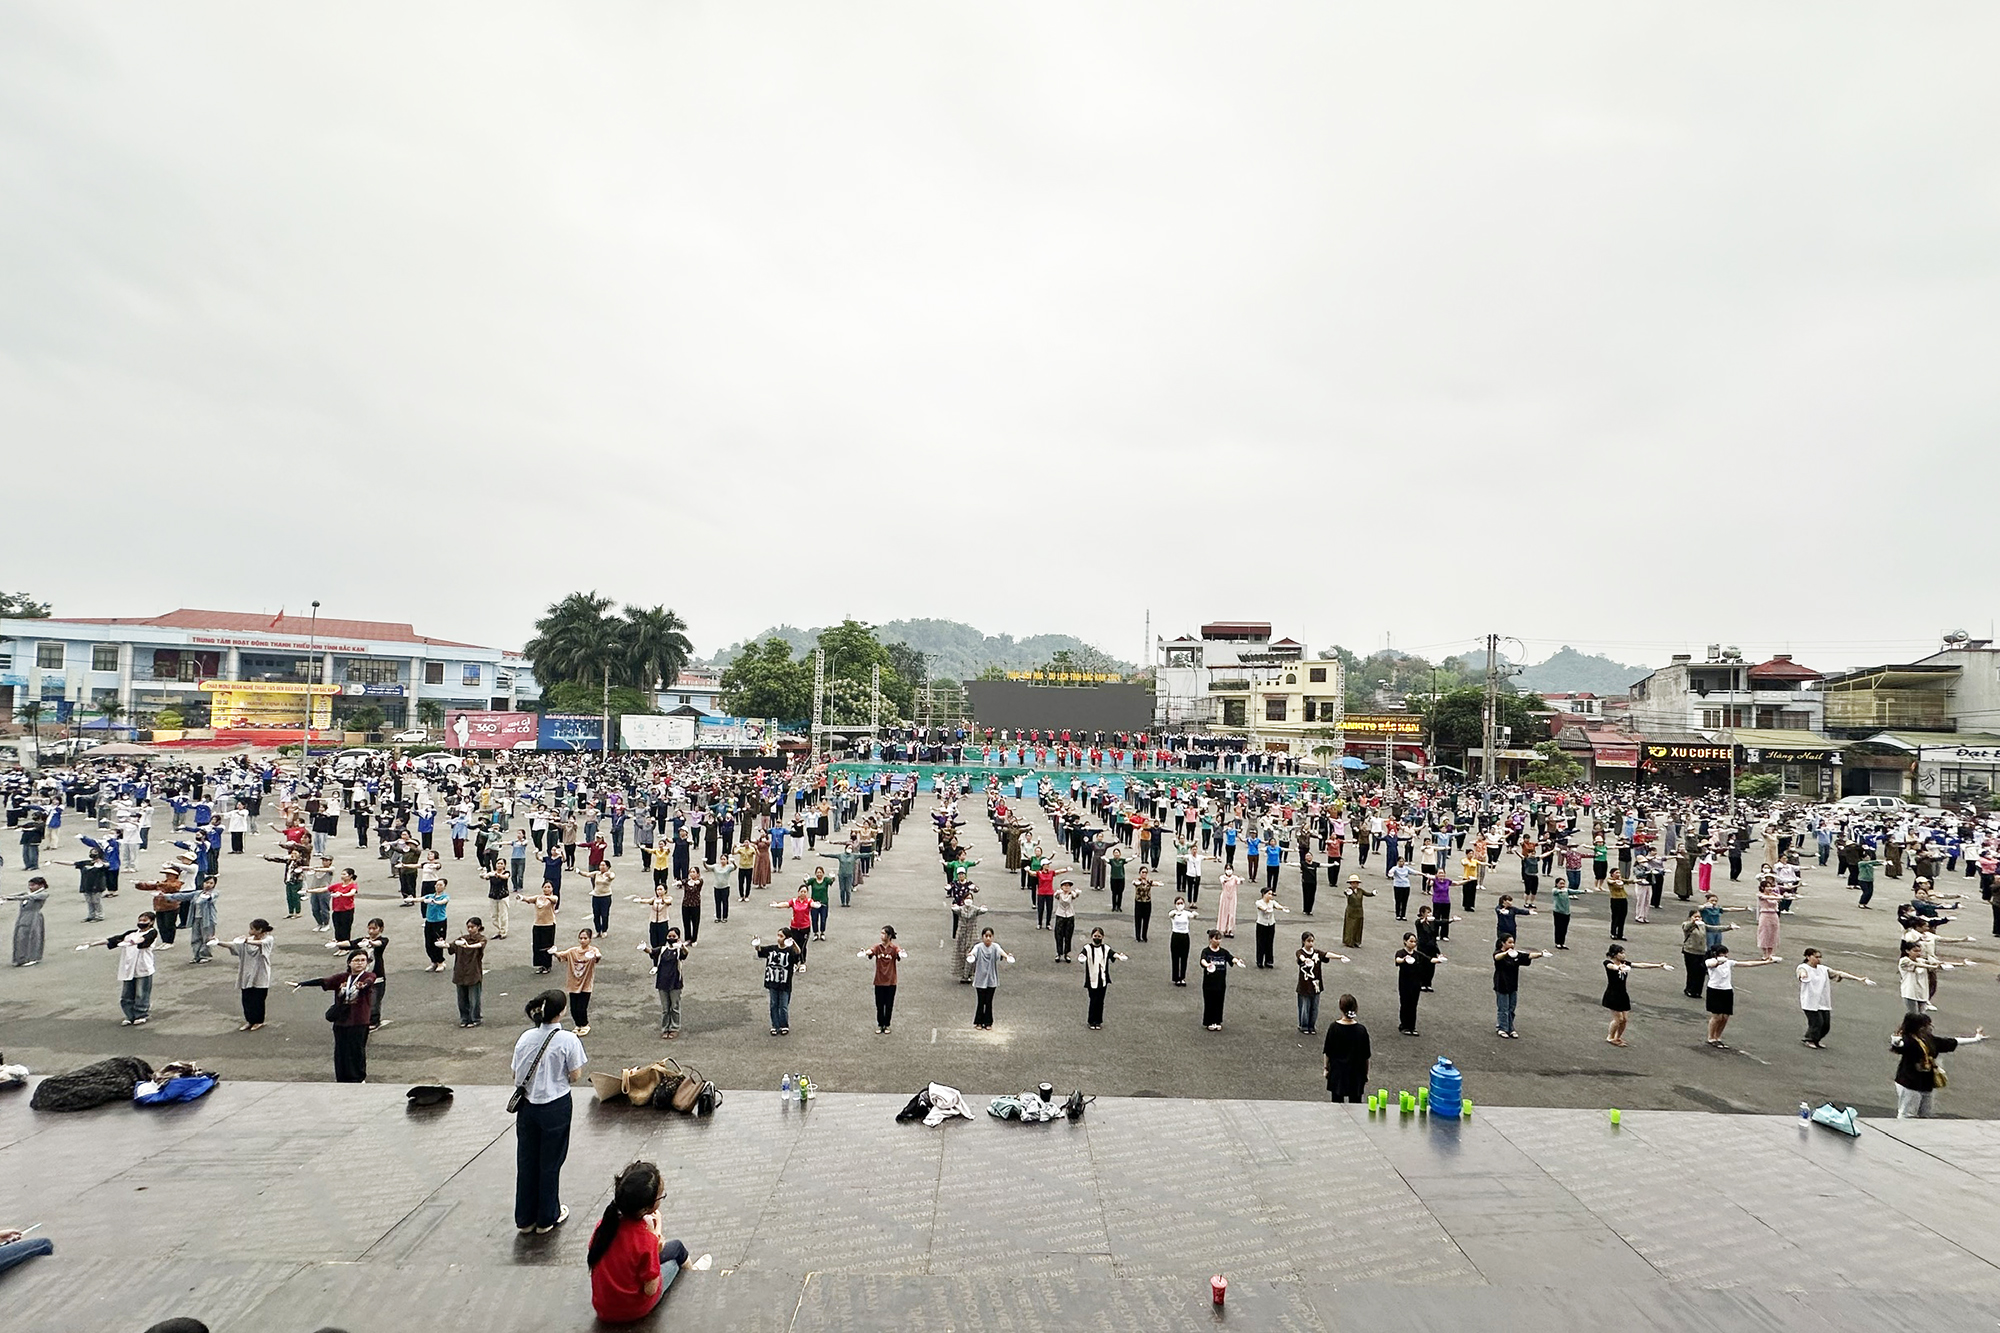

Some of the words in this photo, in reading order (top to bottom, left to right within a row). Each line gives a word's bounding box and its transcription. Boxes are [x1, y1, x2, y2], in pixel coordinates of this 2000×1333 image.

[476, 724, 496, 732] 360
[1670, 747, 1687, 758] XU
[1689, 748, 1733, 759] COFFEE
[885, 1258, 906, 1266] VIET
[1050, 1266, 1075, 1278] NAM
